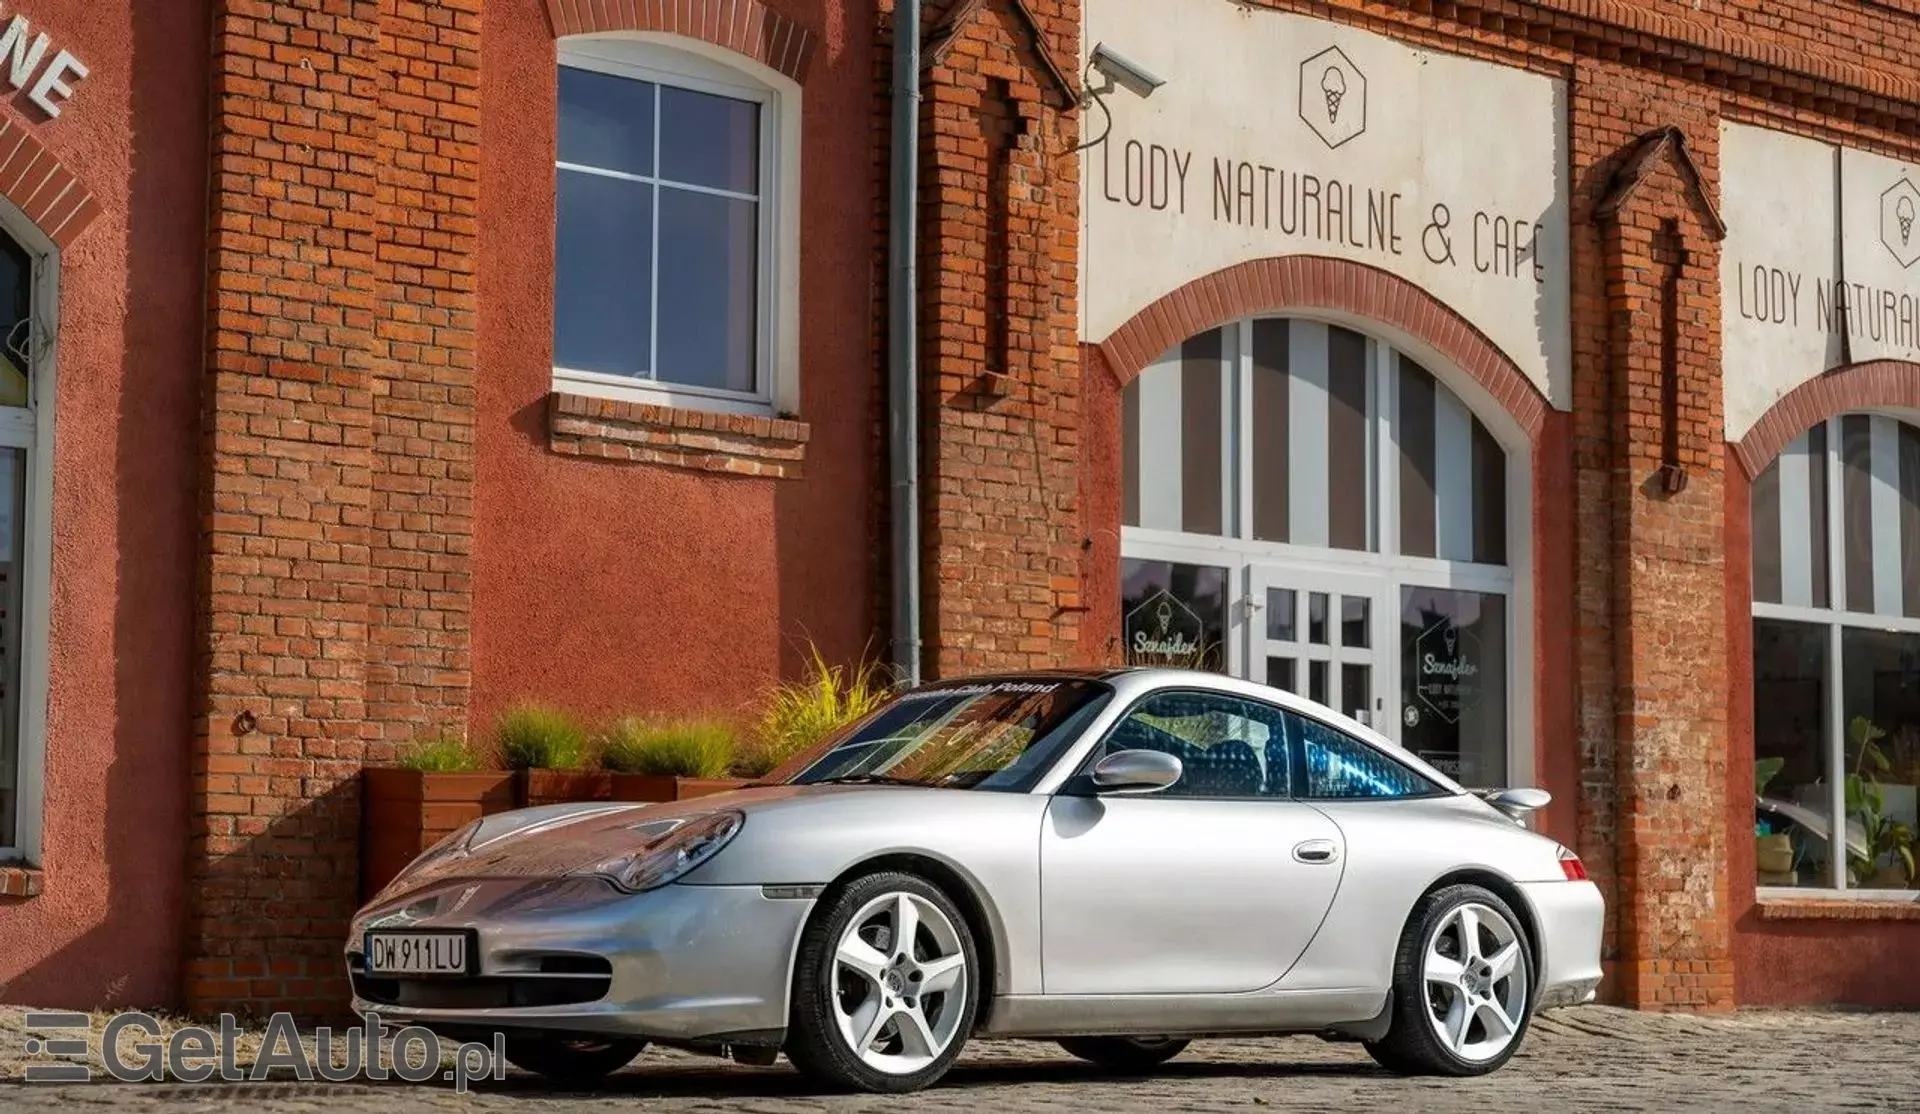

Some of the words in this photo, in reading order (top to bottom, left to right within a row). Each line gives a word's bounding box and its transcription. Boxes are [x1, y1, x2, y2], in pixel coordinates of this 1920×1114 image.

[1104, 135, 1192, 214] LODY
[1213, 156, 1402, 255] NATURALNE
[1421, 202, 1457, 266] &
[1473, 211, 1545, 284] CAFE
[1738, 261, 1802, 328] LODY
[992, 681, 1063, 694] Poland
[373, 937, 396, 969] DW
[401, 937, 463, 969] 911LU
